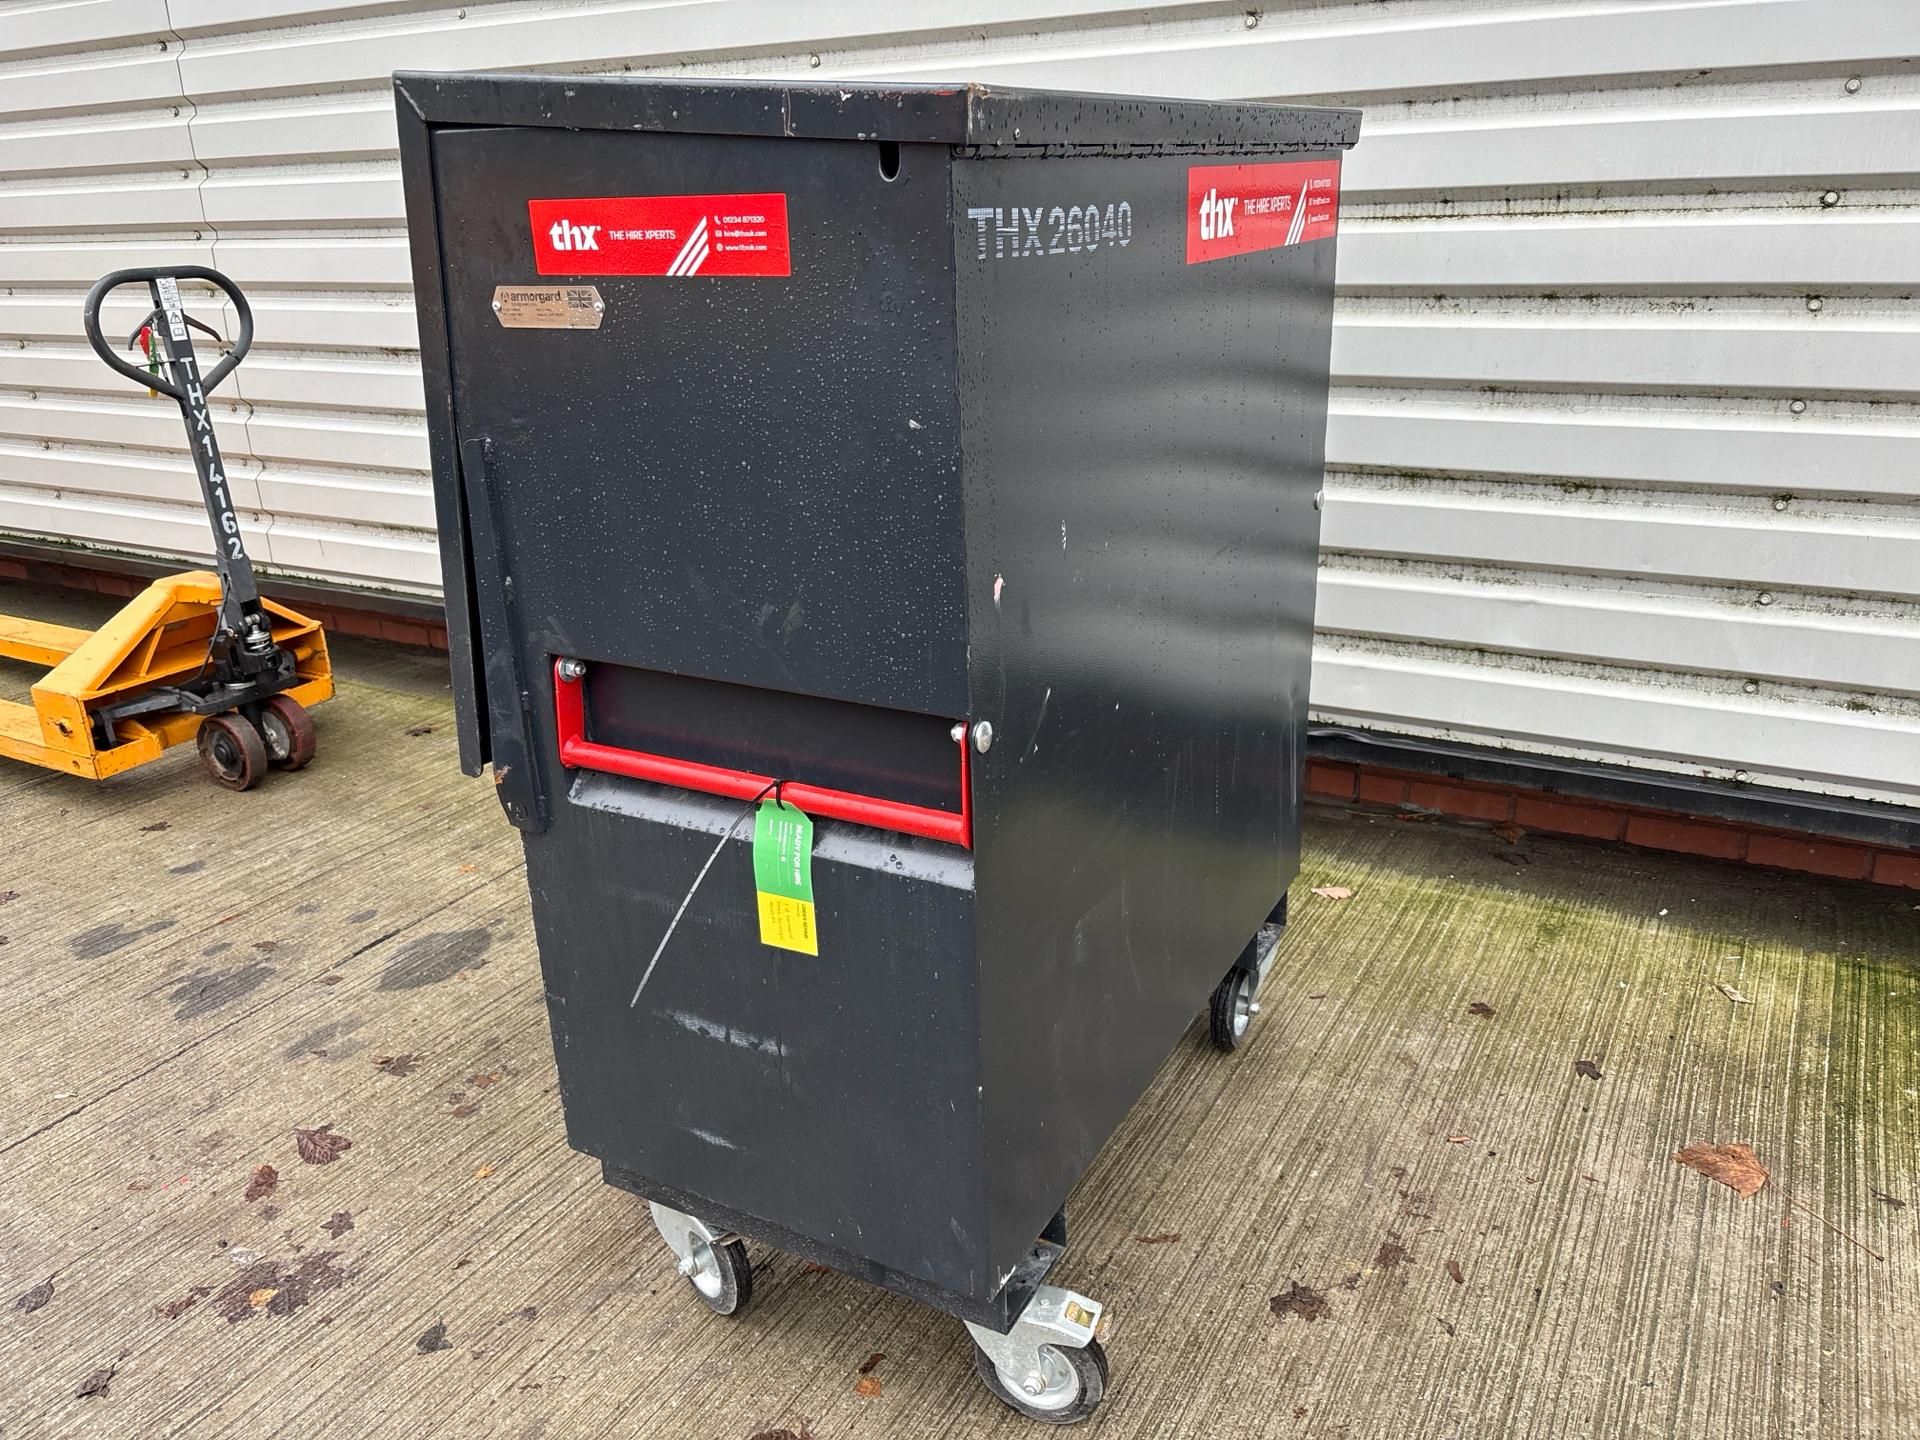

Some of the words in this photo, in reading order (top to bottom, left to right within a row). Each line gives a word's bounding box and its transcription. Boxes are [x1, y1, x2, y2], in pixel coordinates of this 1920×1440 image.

[1199, 188, 1236, 241] thx
[1244, 199, 1255, 216] THE
[1256, 197, 1270, 215] HIRE
[1270, 195, 1291, 213] XPERTS
[549, 219, 600, 251] thx
[608, 230, 625, 240] THE
[625, 230, 644, 240] HIRE
[645, 229, 676, 240] XPERTS
[510, 290, 561, 303] armorgard
[179, 357, 244, 561] THX14162
[794, 824, 803, 851] READY
[793, 851, 801, 869] FOR
[793, 868, 802, 887] HIRE
